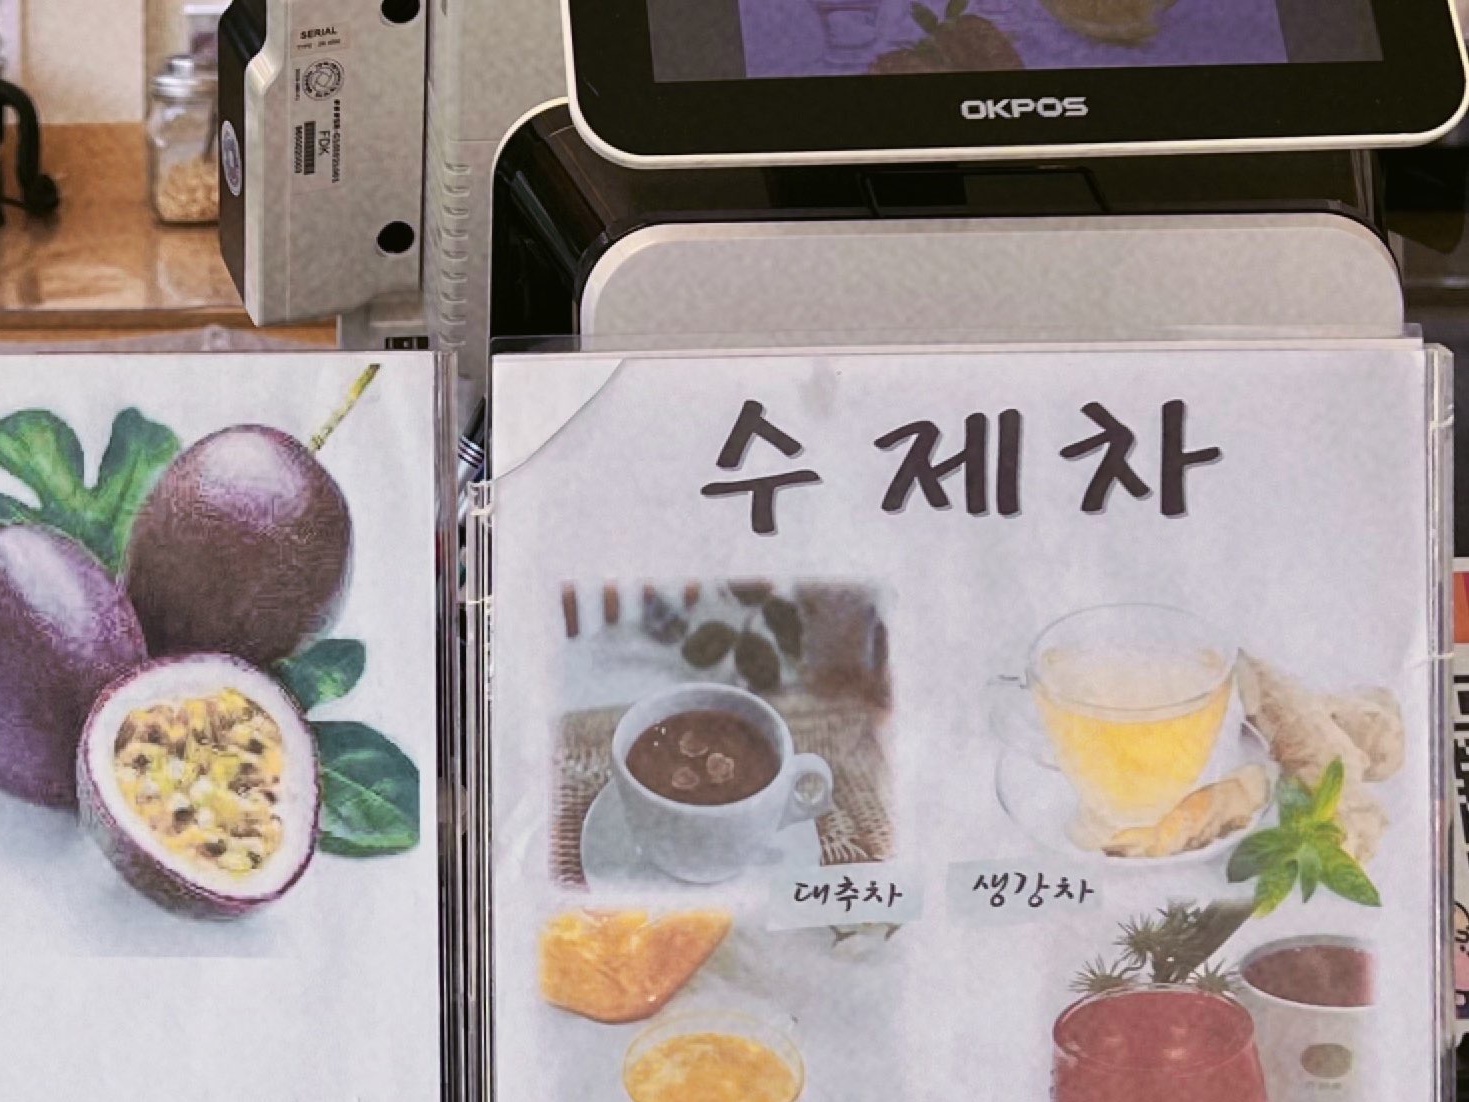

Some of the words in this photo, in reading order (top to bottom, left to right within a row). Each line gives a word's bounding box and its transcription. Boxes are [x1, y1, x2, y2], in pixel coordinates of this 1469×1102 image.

[300, 27, 337, 39] SERIAL
[960, 96, 1088, 120] OKPOS
[794, 875, 903, 912] 대추차
[972, 872, 1095, 908] 생강차
